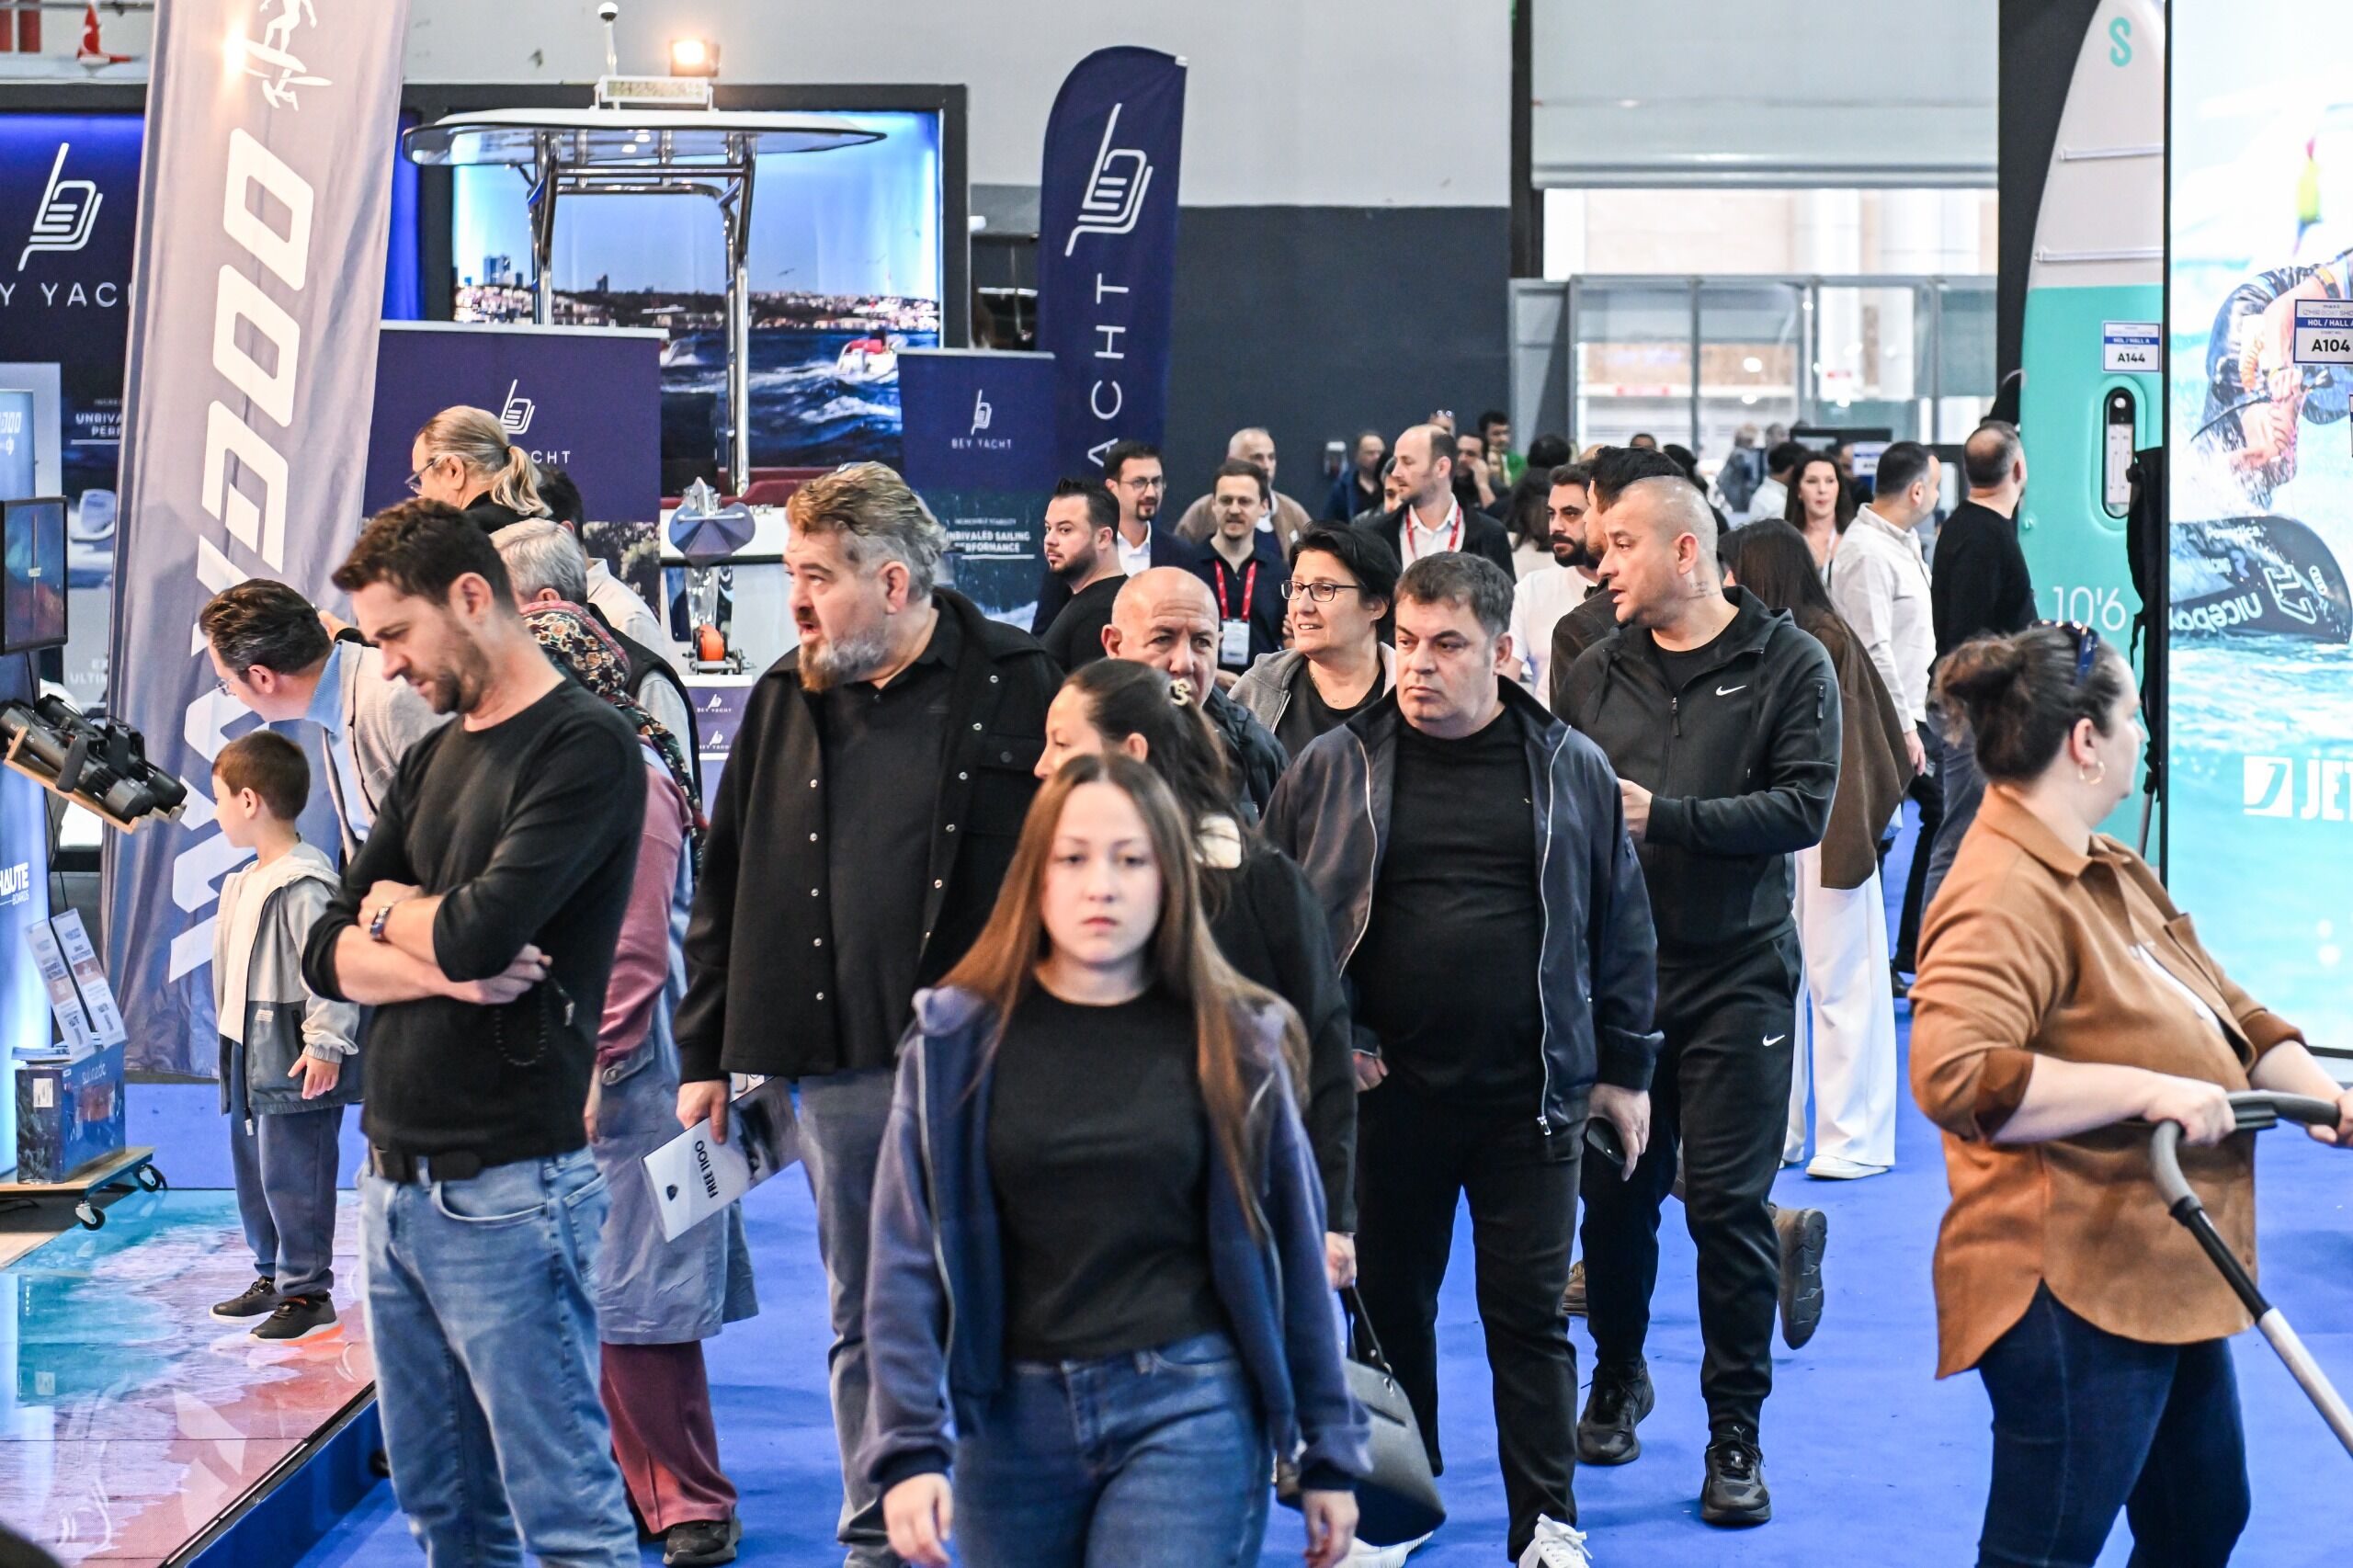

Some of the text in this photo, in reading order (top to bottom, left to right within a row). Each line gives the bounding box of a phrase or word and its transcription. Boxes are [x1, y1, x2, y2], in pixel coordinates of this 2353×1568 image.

[2329, 319, 2349, 327] HALL
[2311, 338, 2351, 353] A104
[2117, 352, 2146, 363] A144
[977, 437, 1012, 450] YACHT
[995, 530, 1031, 542] SAILING
[169, 127, 314, 983] WADOO
[703, 1170, 719, 1199] FREE
